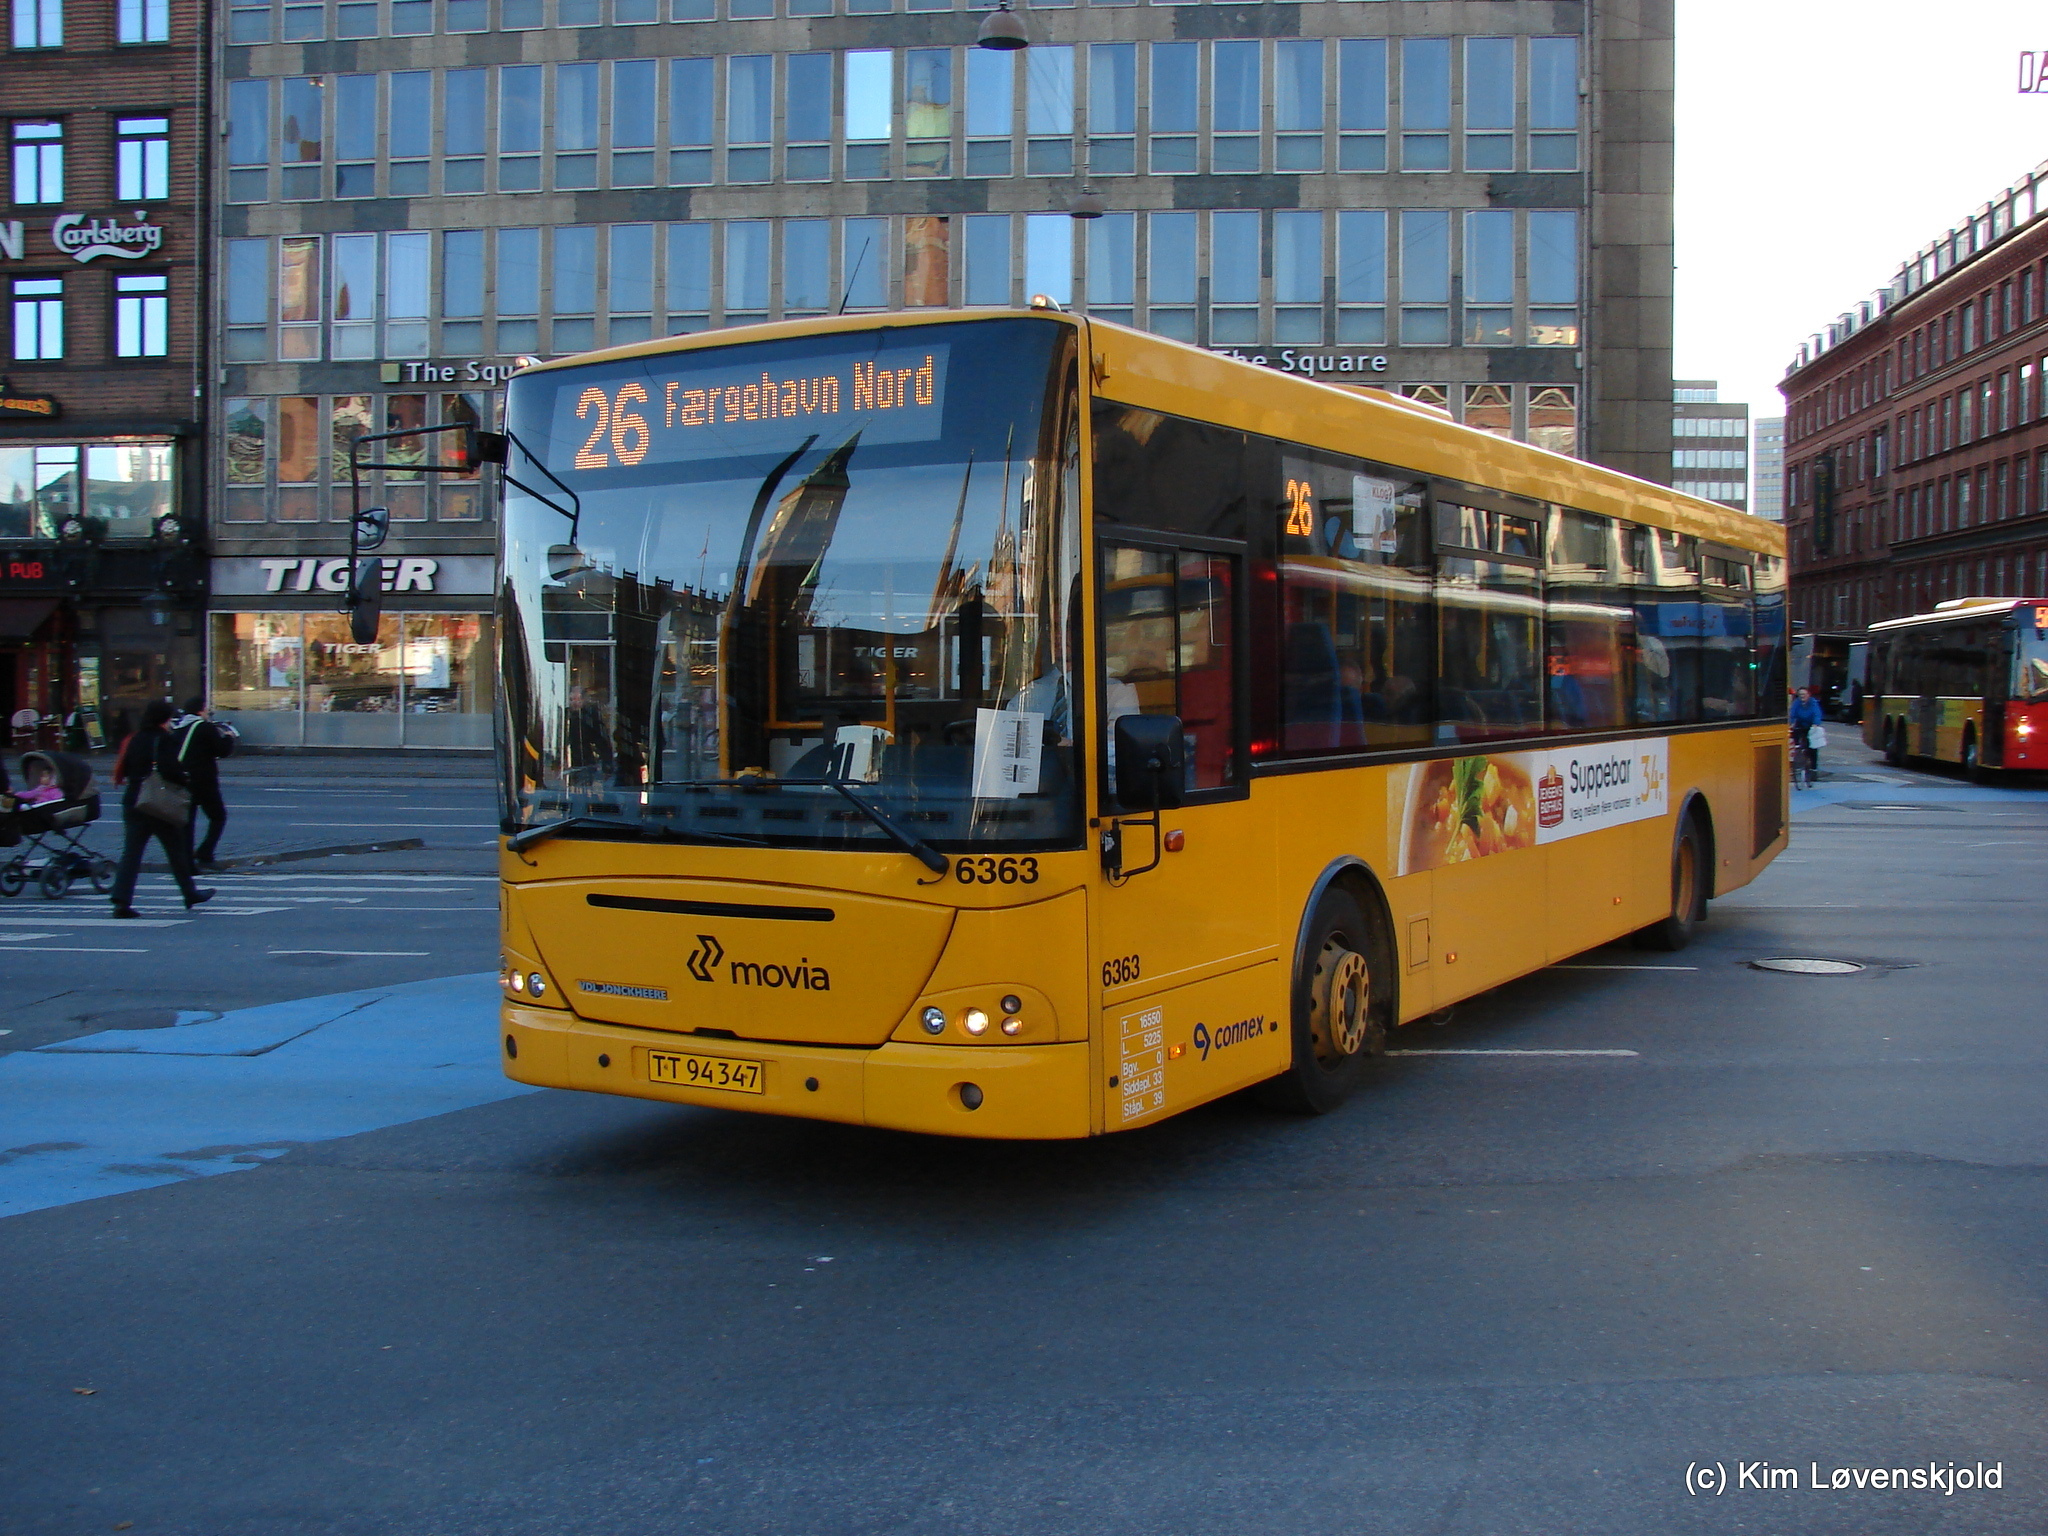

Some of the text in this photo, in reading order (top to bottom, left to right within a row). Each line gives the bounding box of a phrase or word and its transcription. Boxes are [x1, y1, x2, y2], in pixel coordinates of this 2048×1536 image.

[52, 212, 163, 254] Carlsberg
[406, 361, 456, 383] The
[1281, 350, 1388, 377] Square
[574, 354, 935, 470] 26 Færgehavn Nord
[1286, 478, 1313, 537] 26
[10, 561, 43, 579] PUB
[260, 558, 439, 592] TIGER
[323, 643, 382, 654] TIGER
[854, 646, 919, 658] TIGER
[1570, 754, 1631, 799] Suppebar
[955, 857, 1039, 884] 6363
[730, 957, 831, 991] movia
[1102, 954, 1140, 987] 6363
[577, 980, 668, 1001] VDL JONCKHEERE
[1139, 1010, 1161, 1029] 16550
[1143, 1031, 1162, 1048] 5225
[1215, 1014, 1264, 1050] connex
[652, 1055, 681, 1079] TT
[1156, 1051, 1162, 1064] 0
[1153, 1071, 1163, 1086] 33
[1153, 1090, 1163, 1106] 39
